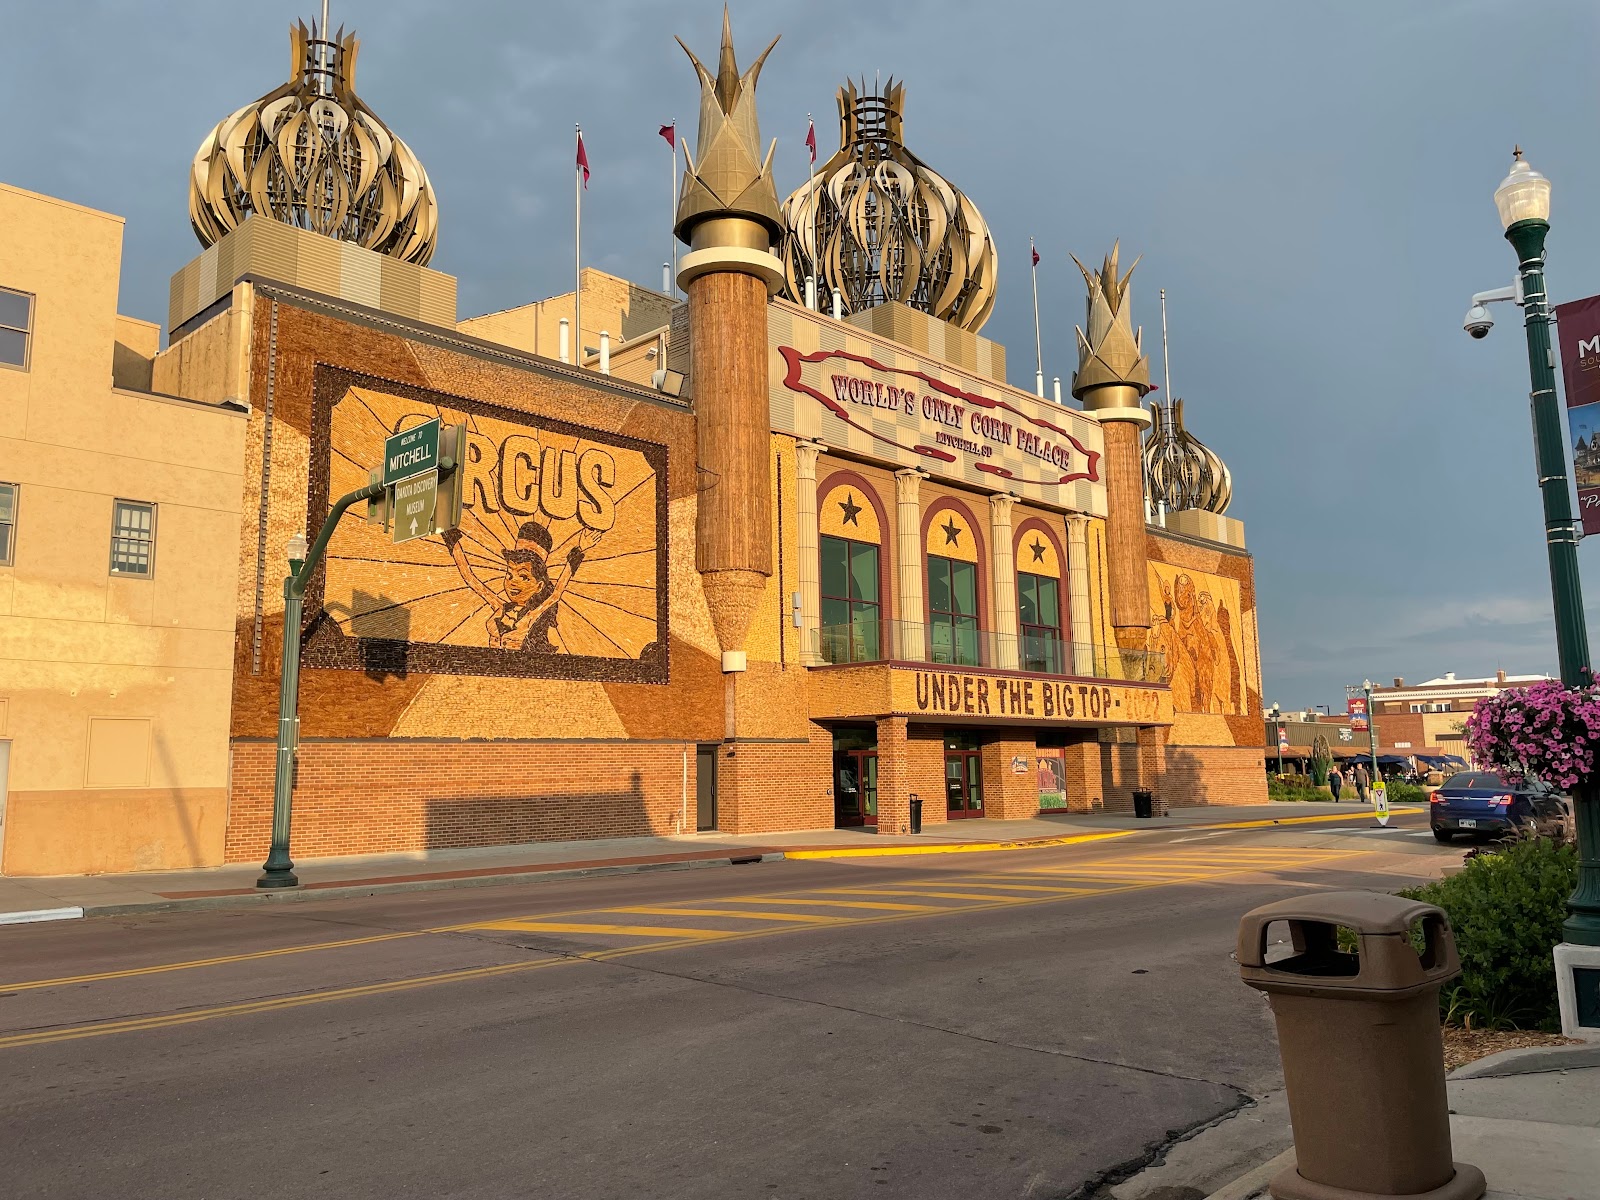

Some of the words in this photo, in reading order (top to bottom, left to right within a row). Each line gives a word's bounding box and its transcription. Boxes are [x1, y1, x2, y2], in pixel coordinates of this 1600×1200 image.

[1578, 335, 1600, 358] M
[831, 374, 916, 415] WORLD'S
[922, 395, 965, 429] ONLY
[971, 412, 1012, 445] CORN
[1016, 428, 1070, 471] PALACE
[400, 433, 417, 446] WELCOME
[417, 430, 423, 440] TO
[390, 444, 432, 472] MITCHELL
[396, 484, 413, 500] DAKOTA
[413, 475, 437, 495] DISCOVERY
[406, 499, 425, 516] MUSEUM
[916, 672, 990, 715] UNDER
[996, 679, 1034, 715] THE
[1043, 682, 1075, 718] BIG
[1078, 685, 1112, 719] TOP
[1124, 688, 1160, 721] 2022
